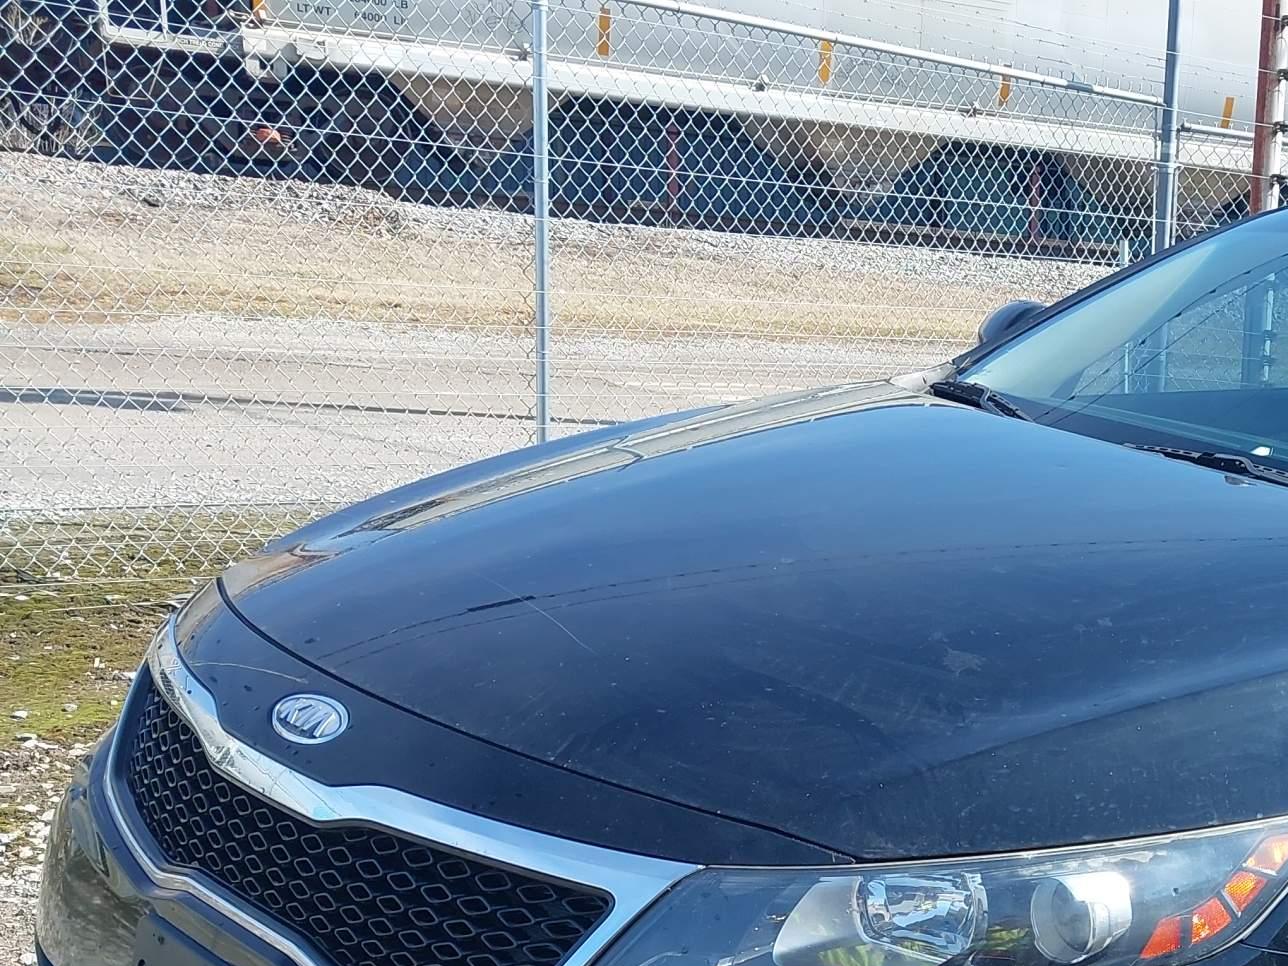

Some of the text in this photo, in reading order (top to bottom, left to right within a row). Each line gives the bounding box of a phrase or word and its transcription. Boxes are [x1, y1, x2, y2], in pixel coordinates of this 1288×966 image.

[296, 3, 309, 12] LT
[314, 6, 331, 15] WT
[278, 697, 338, 739] KIA
